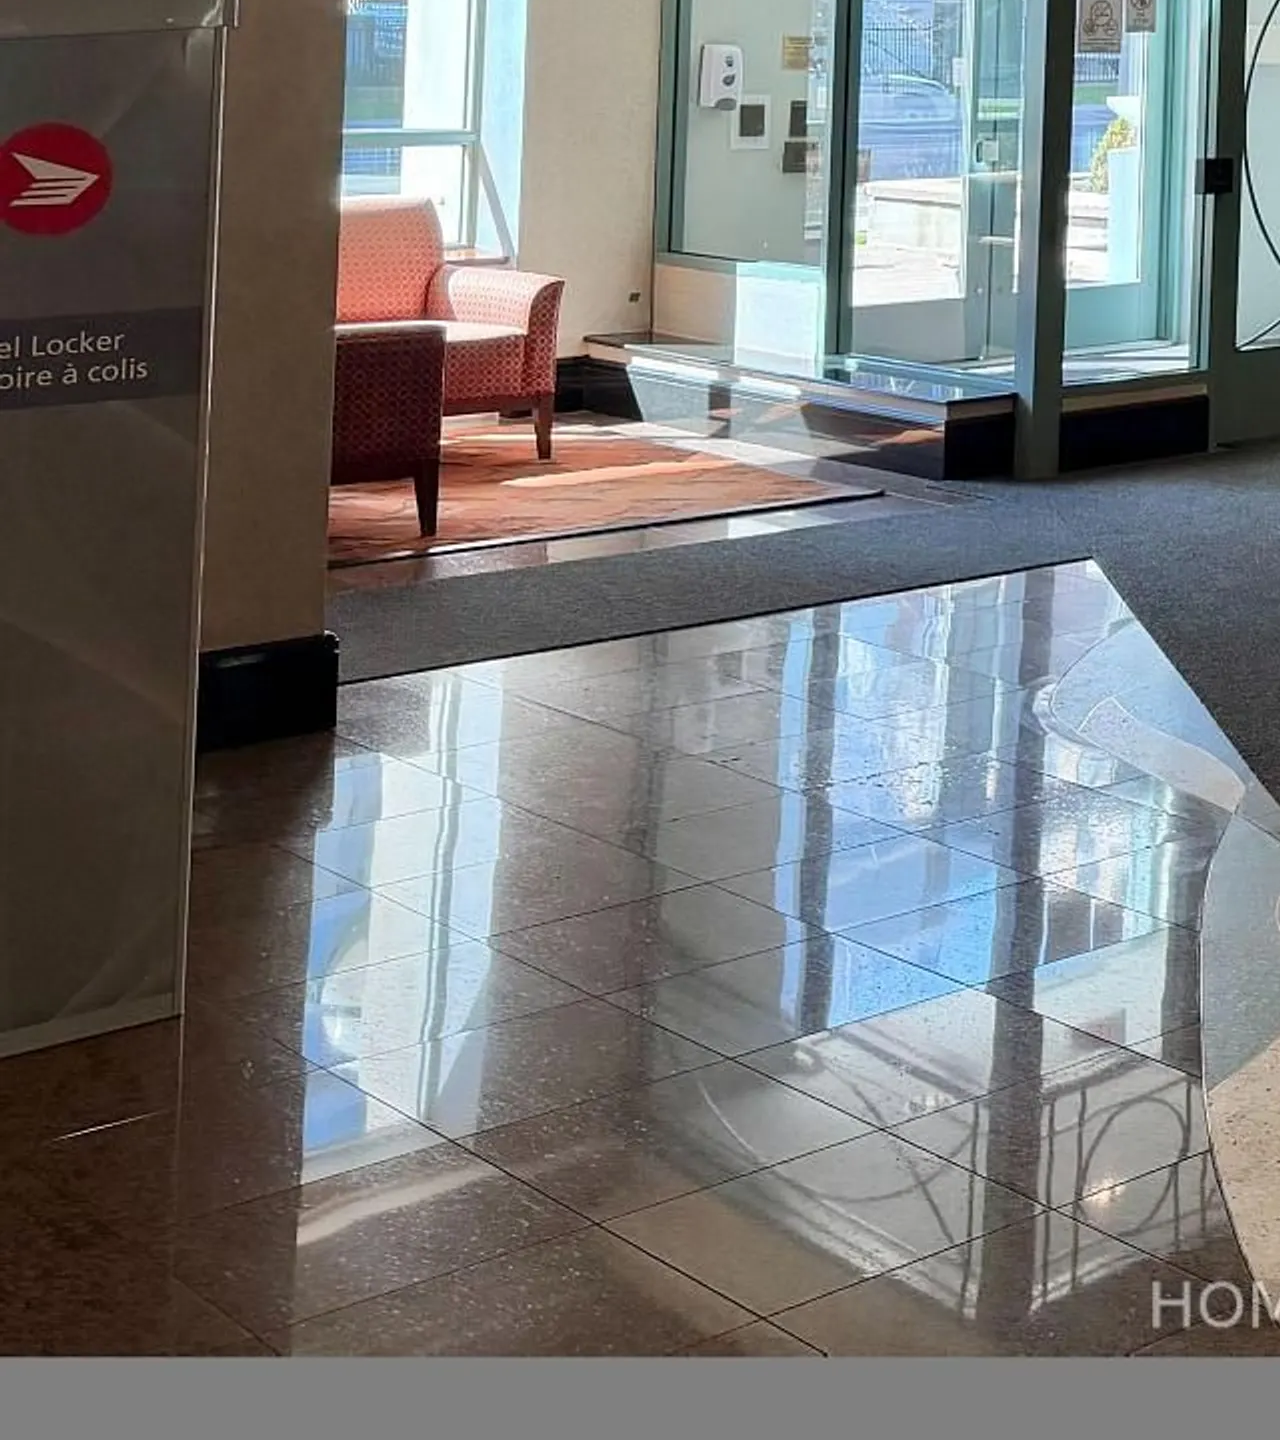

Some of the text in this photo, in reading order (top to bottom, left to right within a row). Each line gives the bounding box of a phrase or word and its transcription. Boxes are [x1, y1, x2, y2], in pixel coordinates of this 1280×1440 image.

[31, 329, 125, 358] Locker
[0, 357, 148, 390] oire à colis
